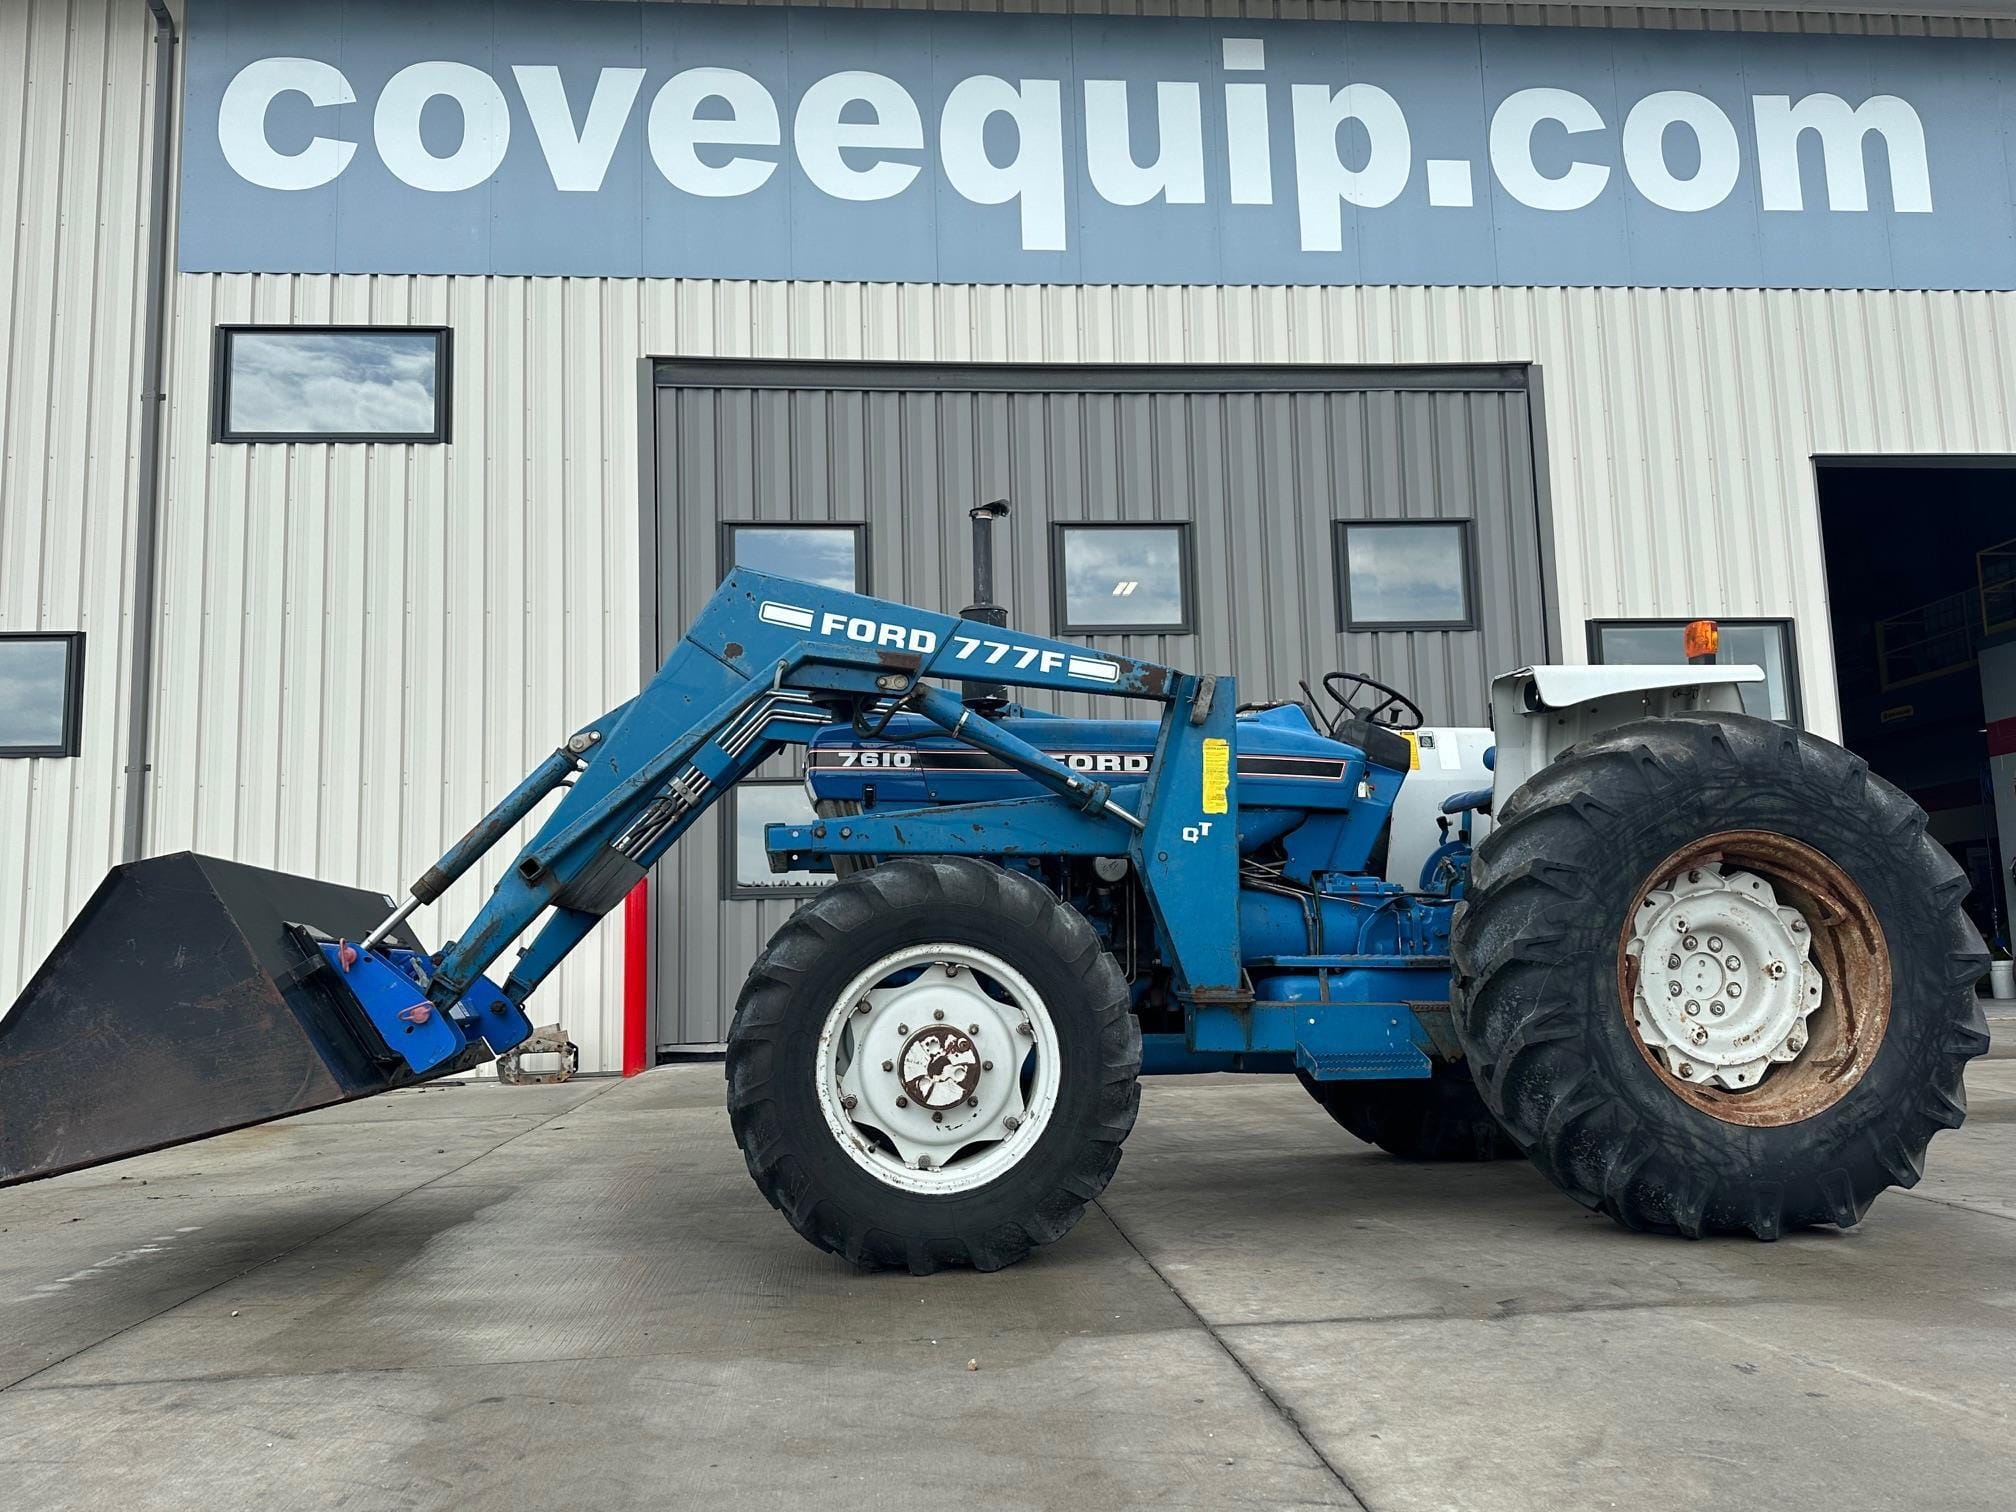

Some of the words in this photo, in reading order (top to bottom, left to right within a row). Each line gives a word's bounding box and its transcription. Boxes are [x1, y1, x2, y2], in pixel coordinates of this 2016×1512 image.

[217, 38, 1933, 252] coveequip.com
[820, 612, 937, 654] FORD
[953, 636, 1065, 673] 777F
[838, 752, 912, 768] 7610
